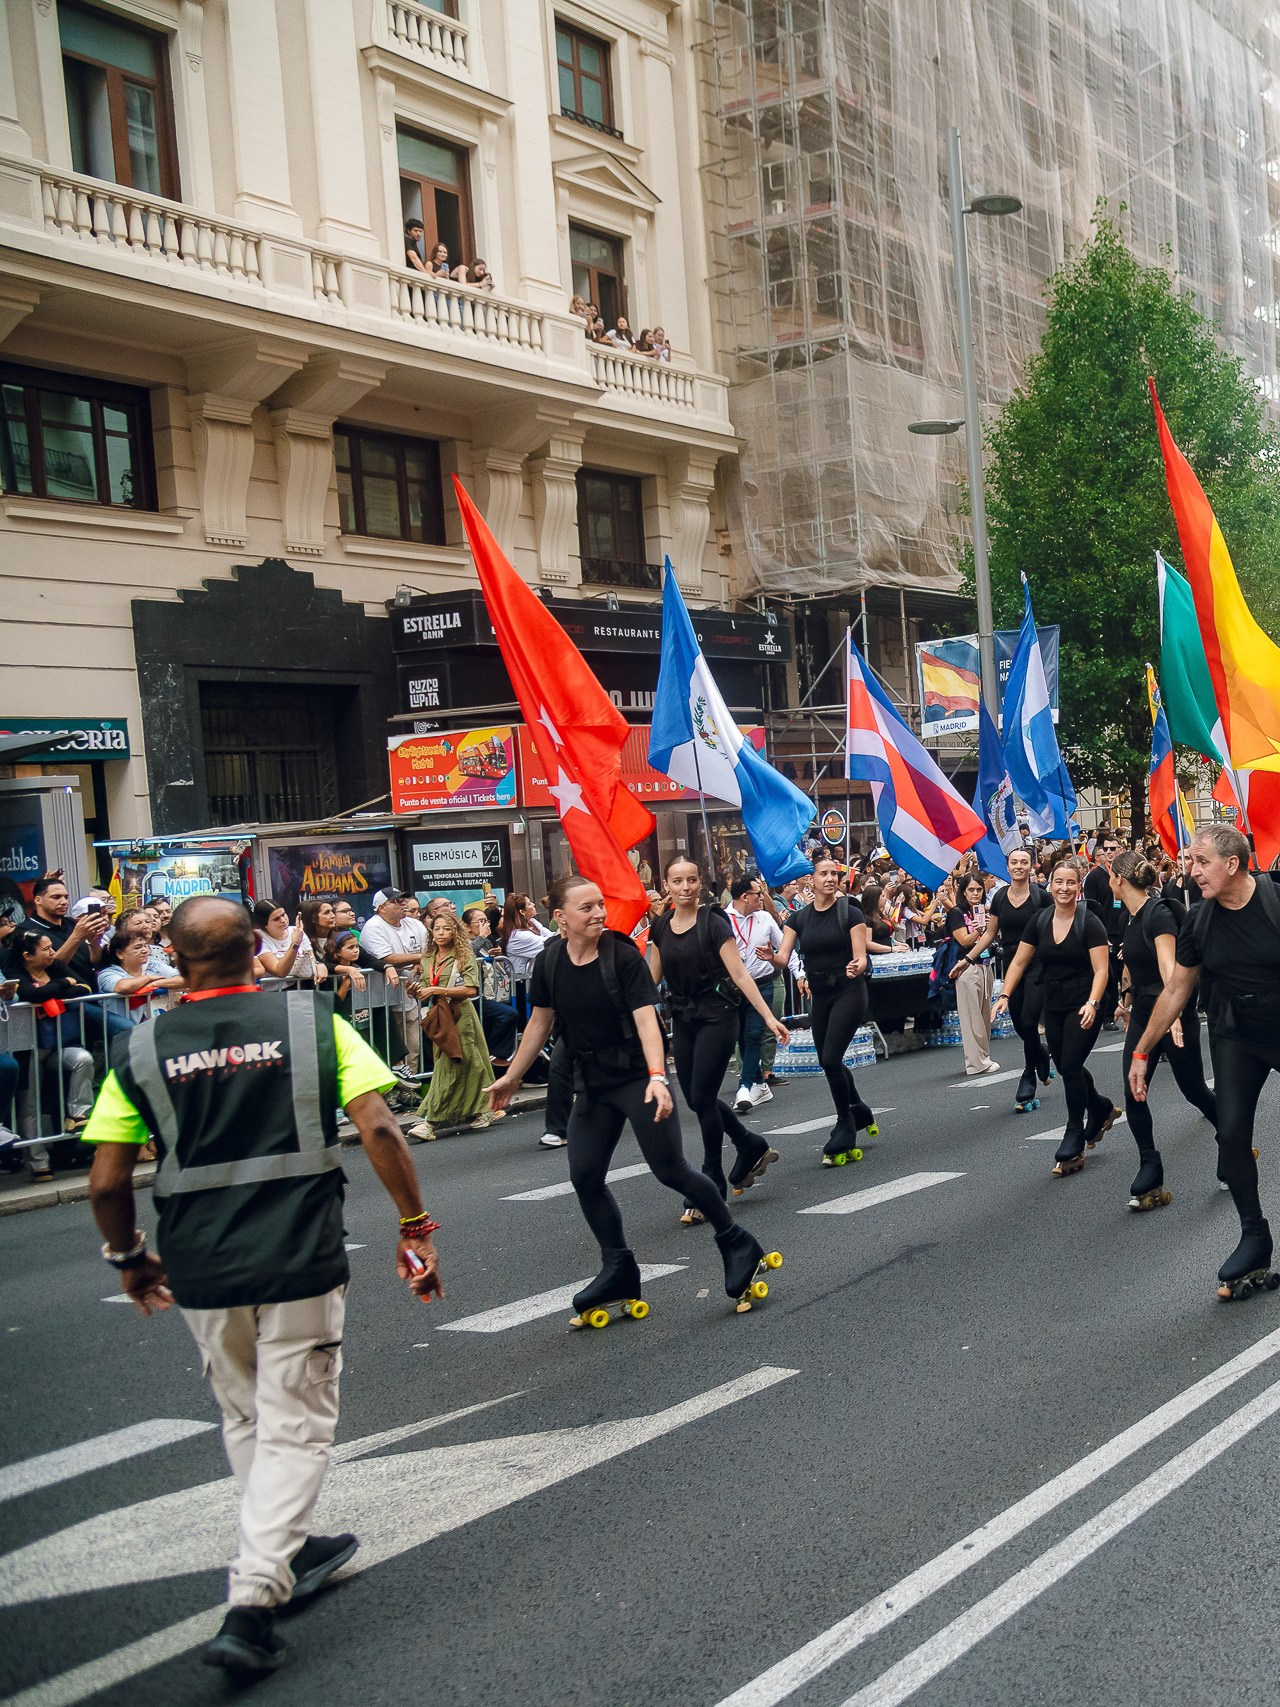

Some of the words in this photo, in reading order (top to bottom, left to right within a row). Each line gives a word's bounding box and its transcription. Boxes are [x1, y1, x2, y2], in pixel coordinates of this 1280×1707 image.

[403, 612, 461, 634] ESTRELLA
[422, 630, 444, 640] DAMM
[593, 626, 660, 639] RESTAURANTE
[758, 644, 782, 652] ESTRELLA
[1000, 659, 1013, 670] FIE
[408, 678, 439, 694] CUZCO
[939, 722, 967, 732] MADRID
[411, 757, 434, 770] Madrid
[531, 777, 548, 785] Punt
[400, 798, 419, 807] Punto
[420, 797, 429, 806] de
[429, 797, 448, 805] venta
[448, 794, 468, 804] oficial
[473, 793, 496, 802] Tickets
[496, 793, 511, 801] here
[0, 846, 39, 871] rables
[418, 848, 478, 862] IBERMÚSICA
[300, 862, 369, 895] ADDAMS
[165, 879, 211, 896] MADRID
[165, 1040, 283, 1079] HAWORK
